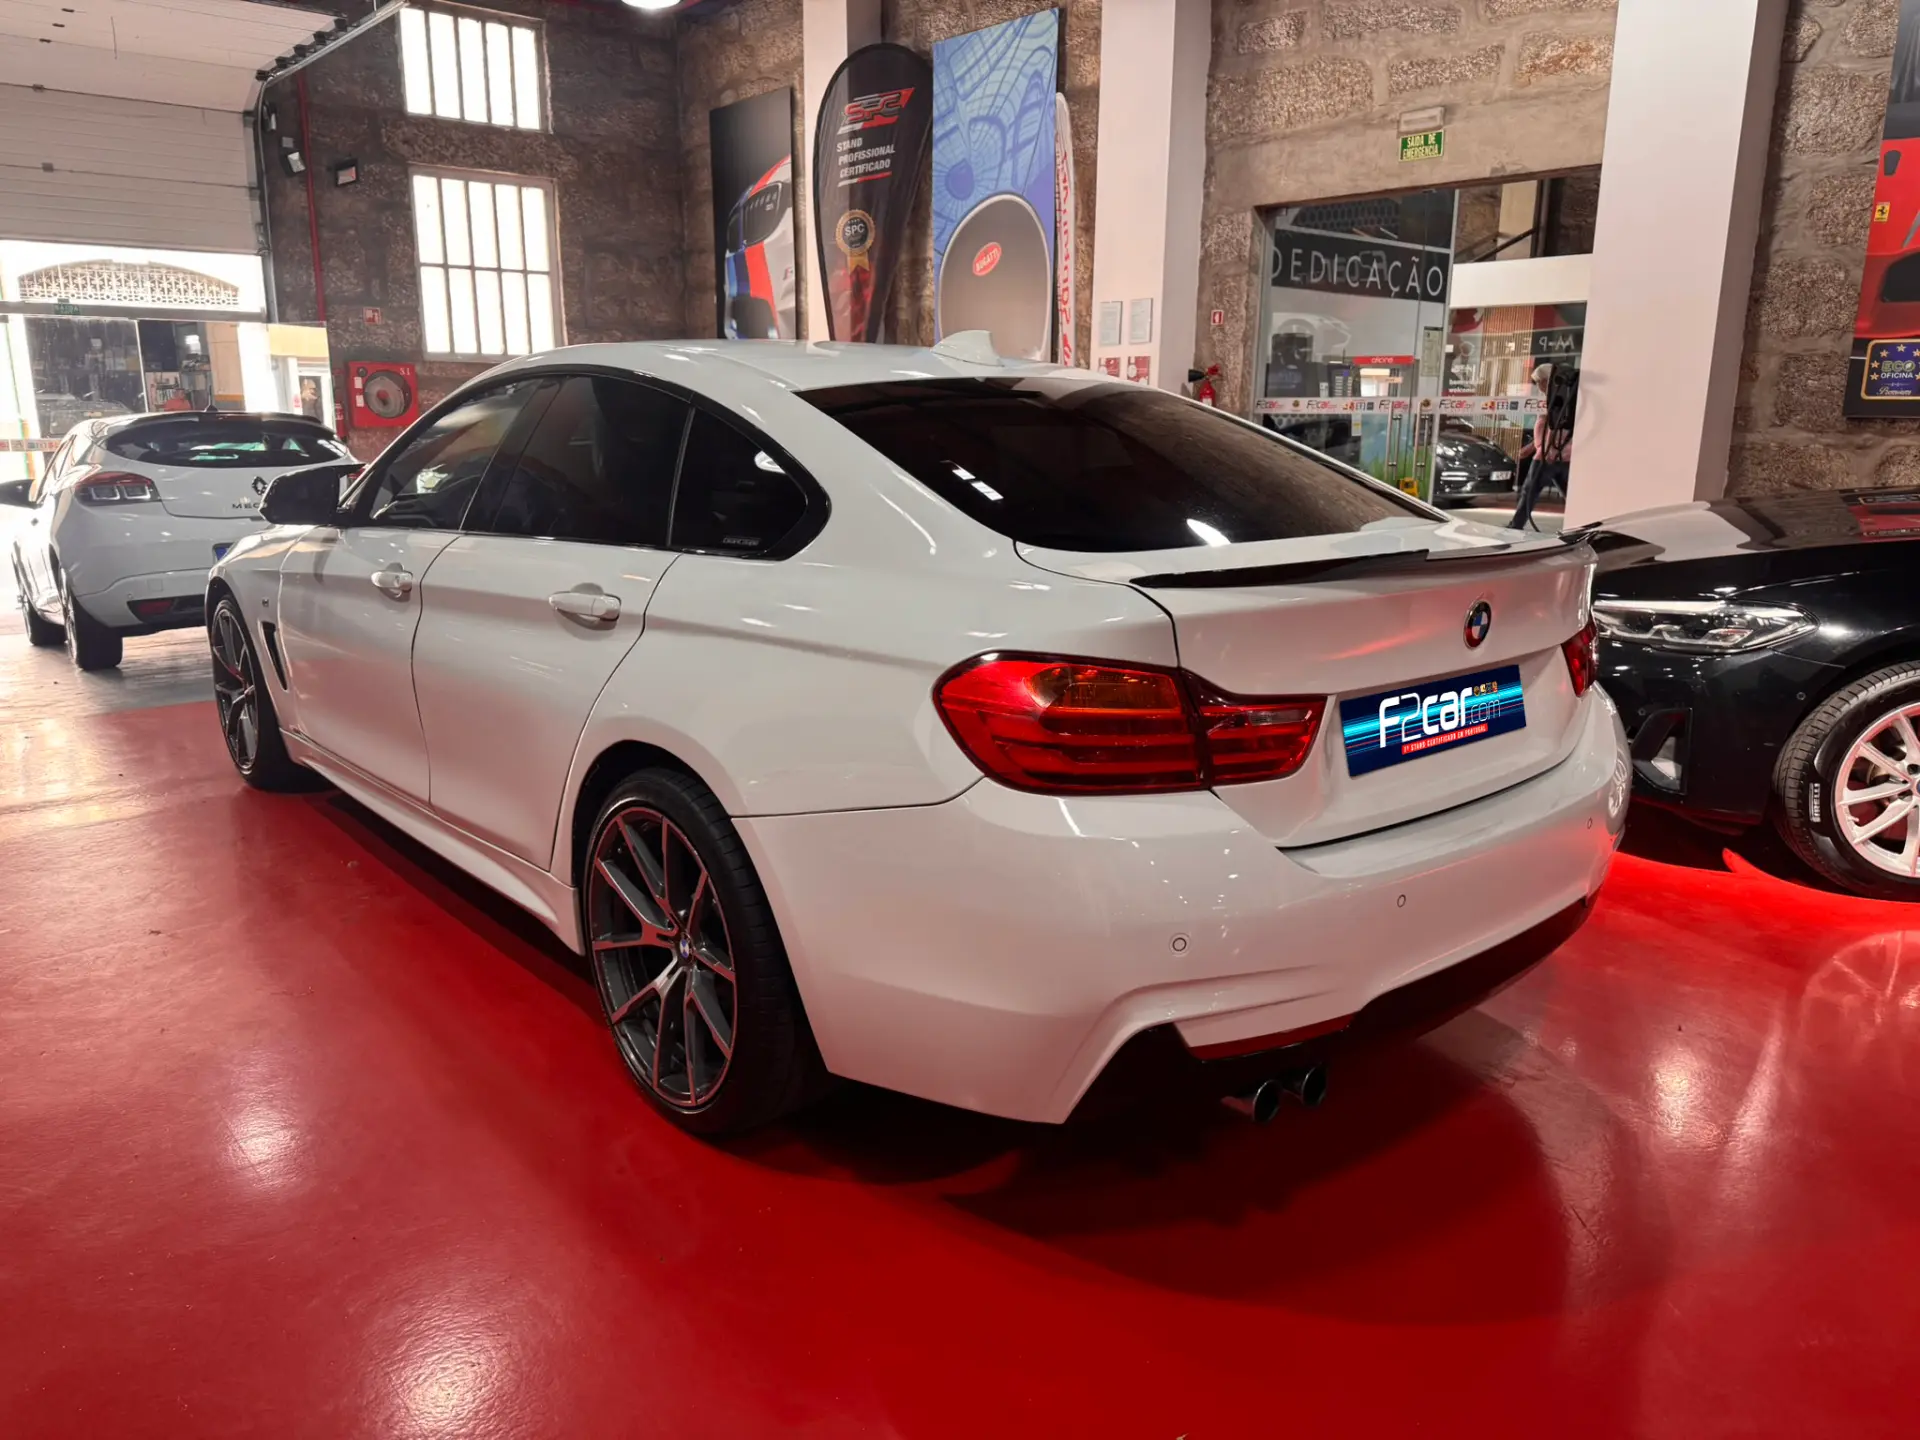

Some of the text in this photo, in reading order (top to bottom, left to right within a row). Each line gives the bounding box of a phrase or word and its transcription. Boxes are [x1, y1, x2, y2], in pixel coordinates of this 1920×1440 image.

[836, 137, 863, 153] STAND
[1428, 132, 1437, 145] DE
[838, 144, 895, 166] PROFISSIONAL
[839, 159, 891, 178] CERTIFICADO
[844, 223, 865, 237] SPC
[1881, 360, 1916, 372] ECO
[1411, 742, 1426, 751] STAND
[1427, 733, 1456, 747] CERTIFICADO
[1465, 725, 1486, 737] PORTUGAL
[1809, 783, 1821, 822] PIRELLI
